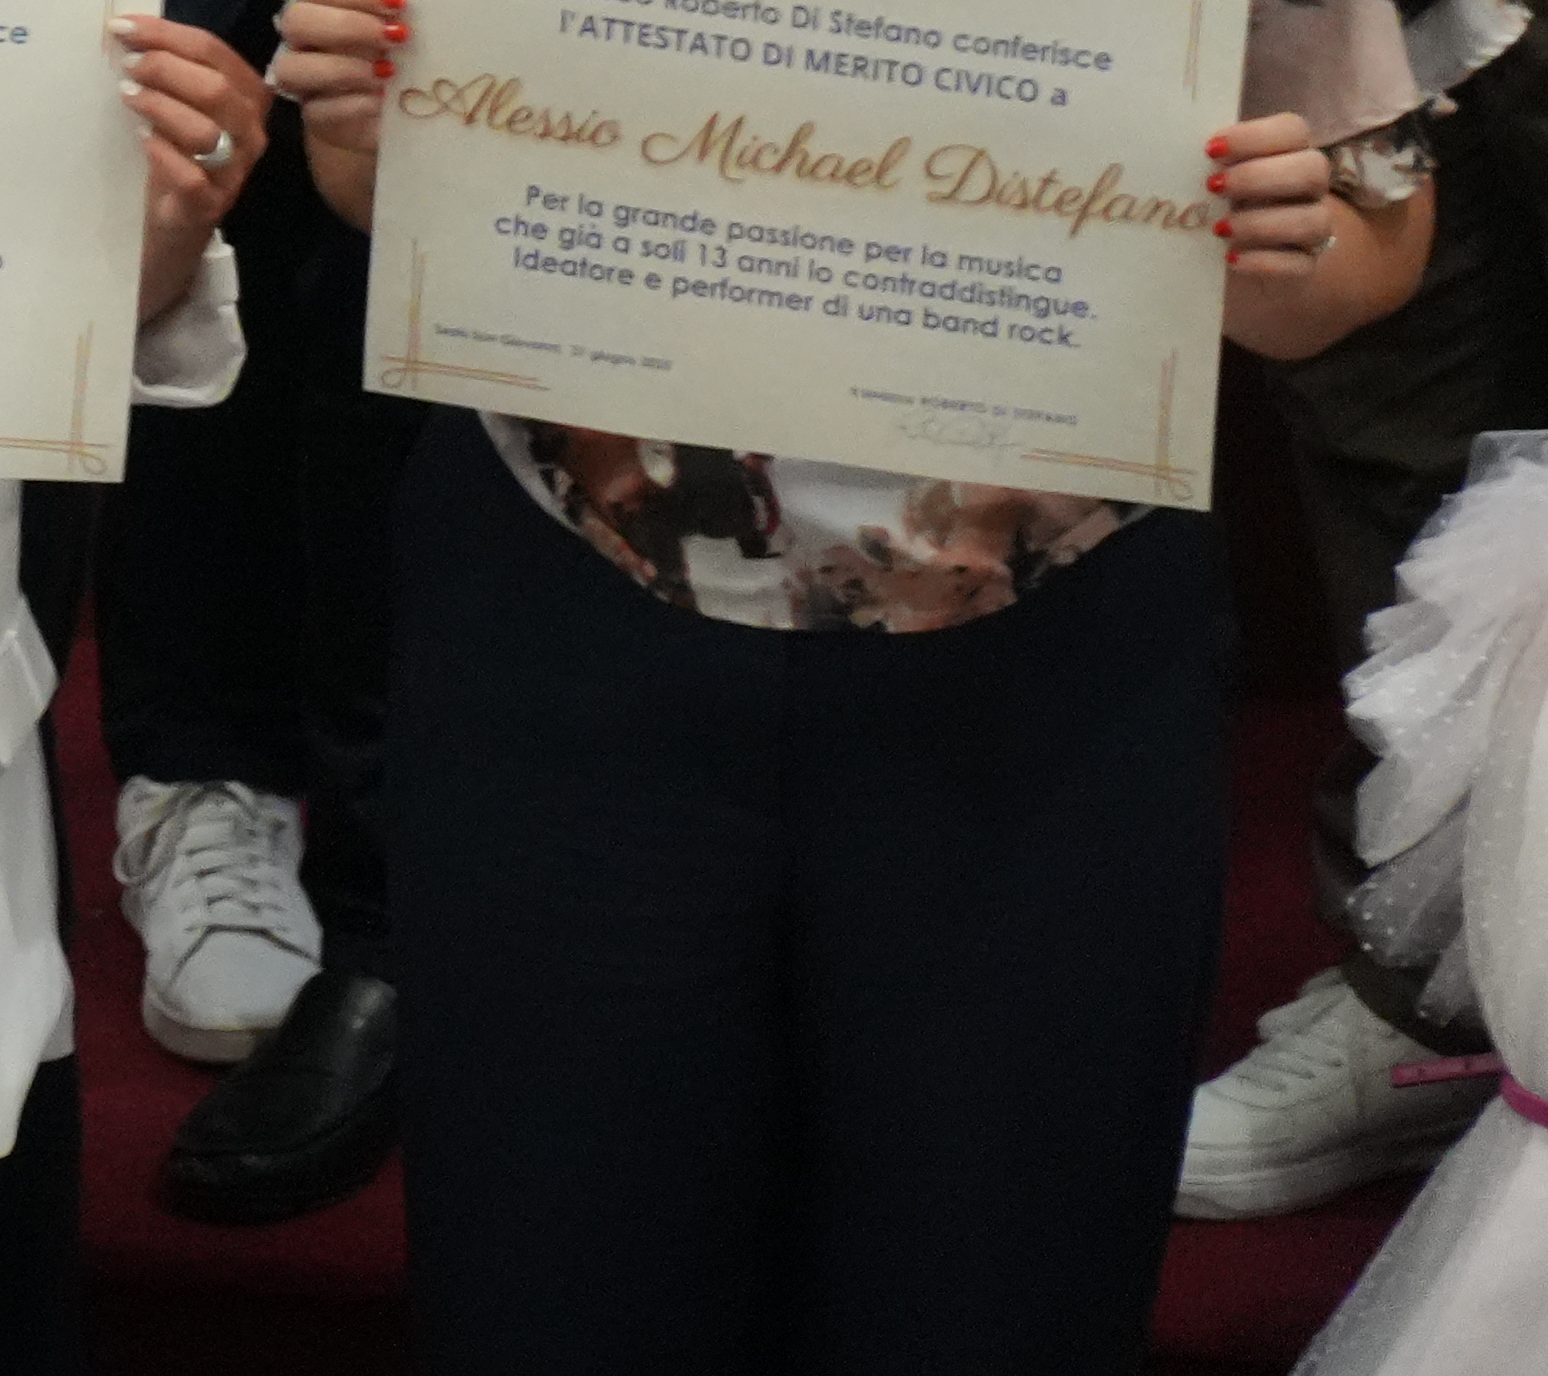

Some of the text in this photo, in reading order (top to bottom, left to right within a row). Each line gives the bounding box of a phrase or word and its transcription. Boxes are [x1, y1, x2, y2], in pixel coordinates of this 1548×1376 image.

[559, 9, 1068, 107] l'ATTESTATO DI MERITO CIVICO a
[791, 4, 820, 31] Di
[828, 9, 943, 50] Stefano
[952, 33, 1113, 71] conferisce
[397, 70, 1216, 242] Alessio Michael Distefano
[494, 213, 1097, 320] che già a soli 13 anni lo contraddistingue.
[525, 184, 1062, 284] Per la grande passione per la musica
[514, 246, 1081, 349] Ideatore e performer di una band rock.
